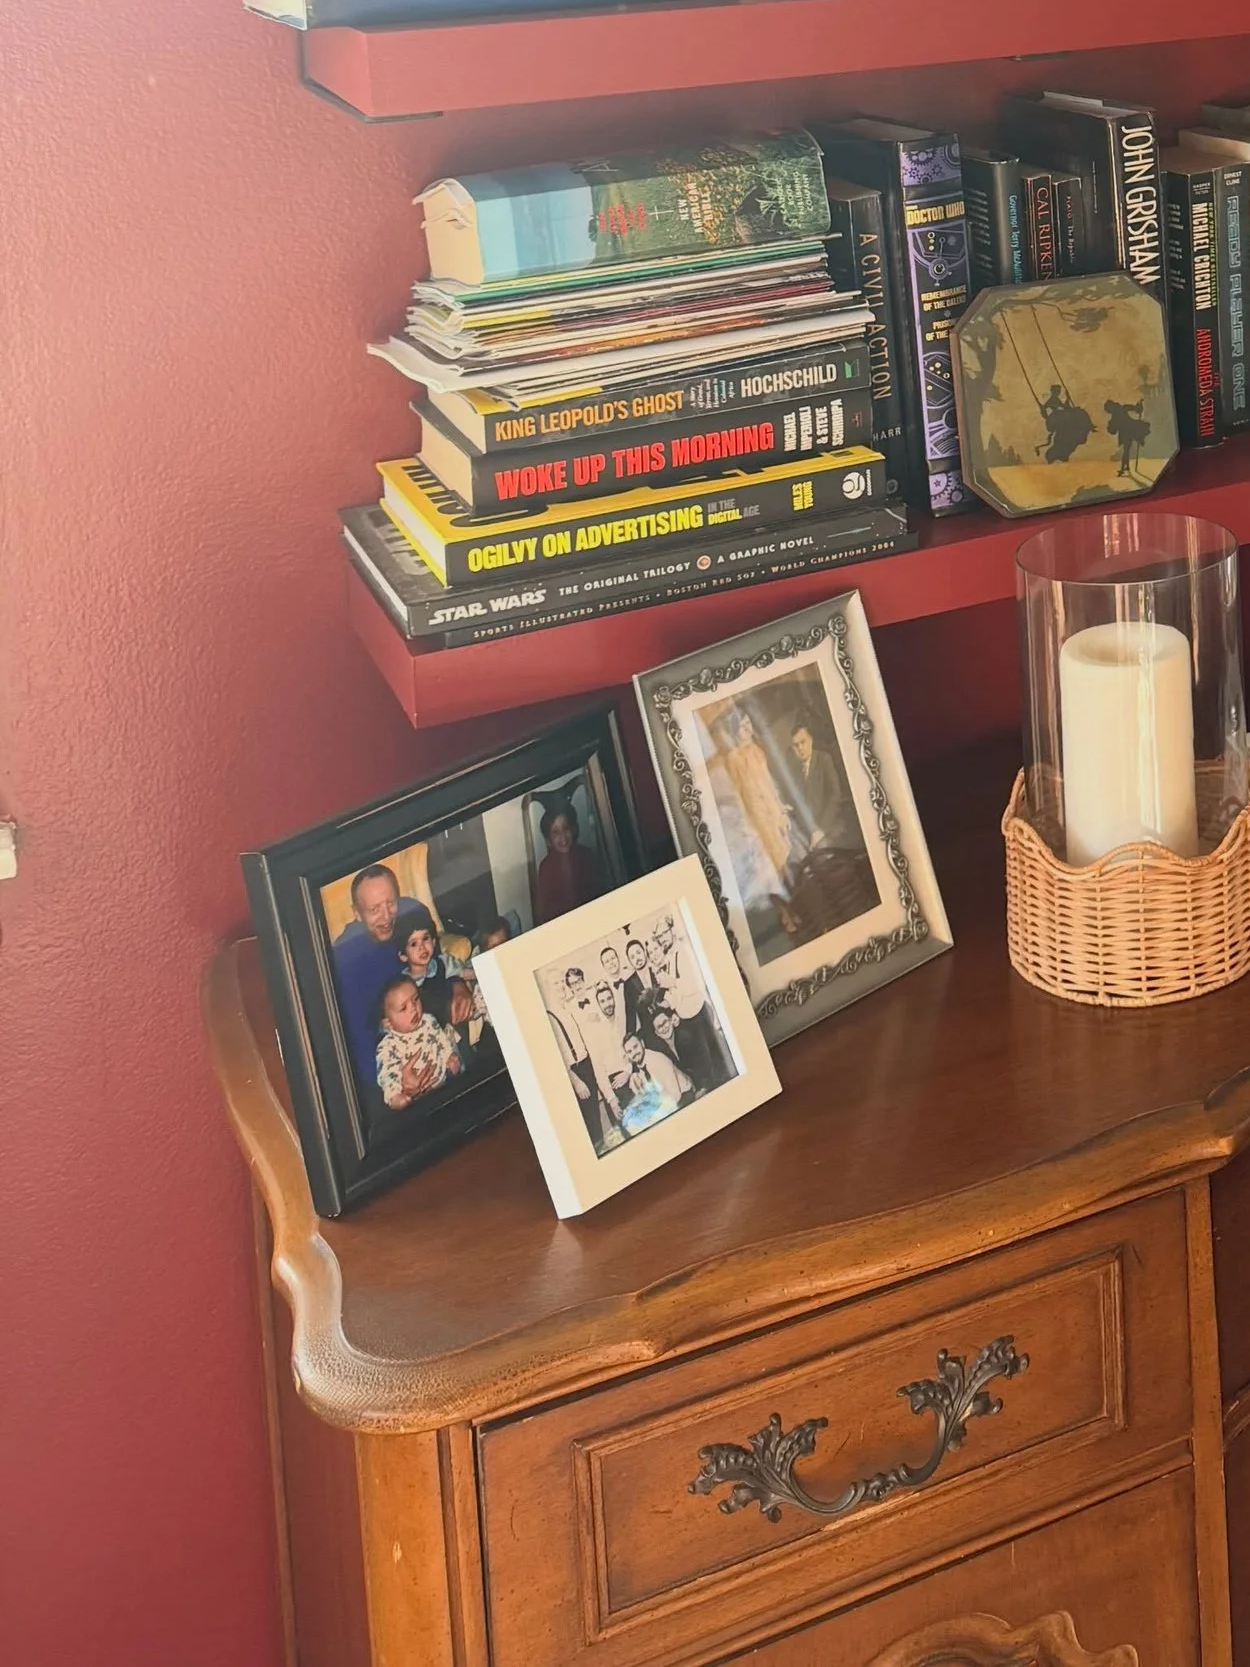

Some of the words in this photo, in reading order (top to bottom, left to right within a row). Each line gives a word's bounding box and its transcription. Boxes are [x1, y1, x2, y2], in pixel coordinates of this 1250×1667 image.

[1122, 125, 1152, 185] JOHN
[679, 198, 690, 221] NEW
[687, 182, 704, 234] AMERICAN
[701, 185, 714, 222] BIBLE
[906, 205, 945, 226] DOCTOR
[945, 201, 966, 218] WHO
[1126, 186, 1162, 285] GRISHAM
[1191, 202, 1211, 251] MICHAEL
[921, 285, 967, 302] REMEMBRANCE
[1193, 252, 1212, 311] CRICHTON
[740, 363, 838, 397] HOCHSCHILD
[494, 417, 536, 443] KING
[539, 397, 629, 434] LEOPOLD'S
[631, 390, 685, 419] GHOST
[784, 411, 797, 453] MICHAEL
[495, 458, 567, 501] WOKE
[572, 452, 607, 486] UP
[612, 440, 666, 479] THIS
[670, 422, 775, 466] MORNING
[467, 539, 538, 575] OGILVY
[542, 536, 571, 559] ON
[575, 505, 704, 551] ADVERTISING
[558, 583, 580, 597] THE
[583, 572, 639, 593] ORIGINAL
[643, 561, 692, 582] TRILOGY
[666, 580, 708, 598] BOSTON
[712, 574, 732, 588] RED
[428, 601, 487, 627] STAR
[489, 589, 549, 617] WARS
[473, 623, 515, 639] SPORTS
[519, 607, 594, 630] ILLUSTRATED
[599, 594, 651, 616] PRESENTS
